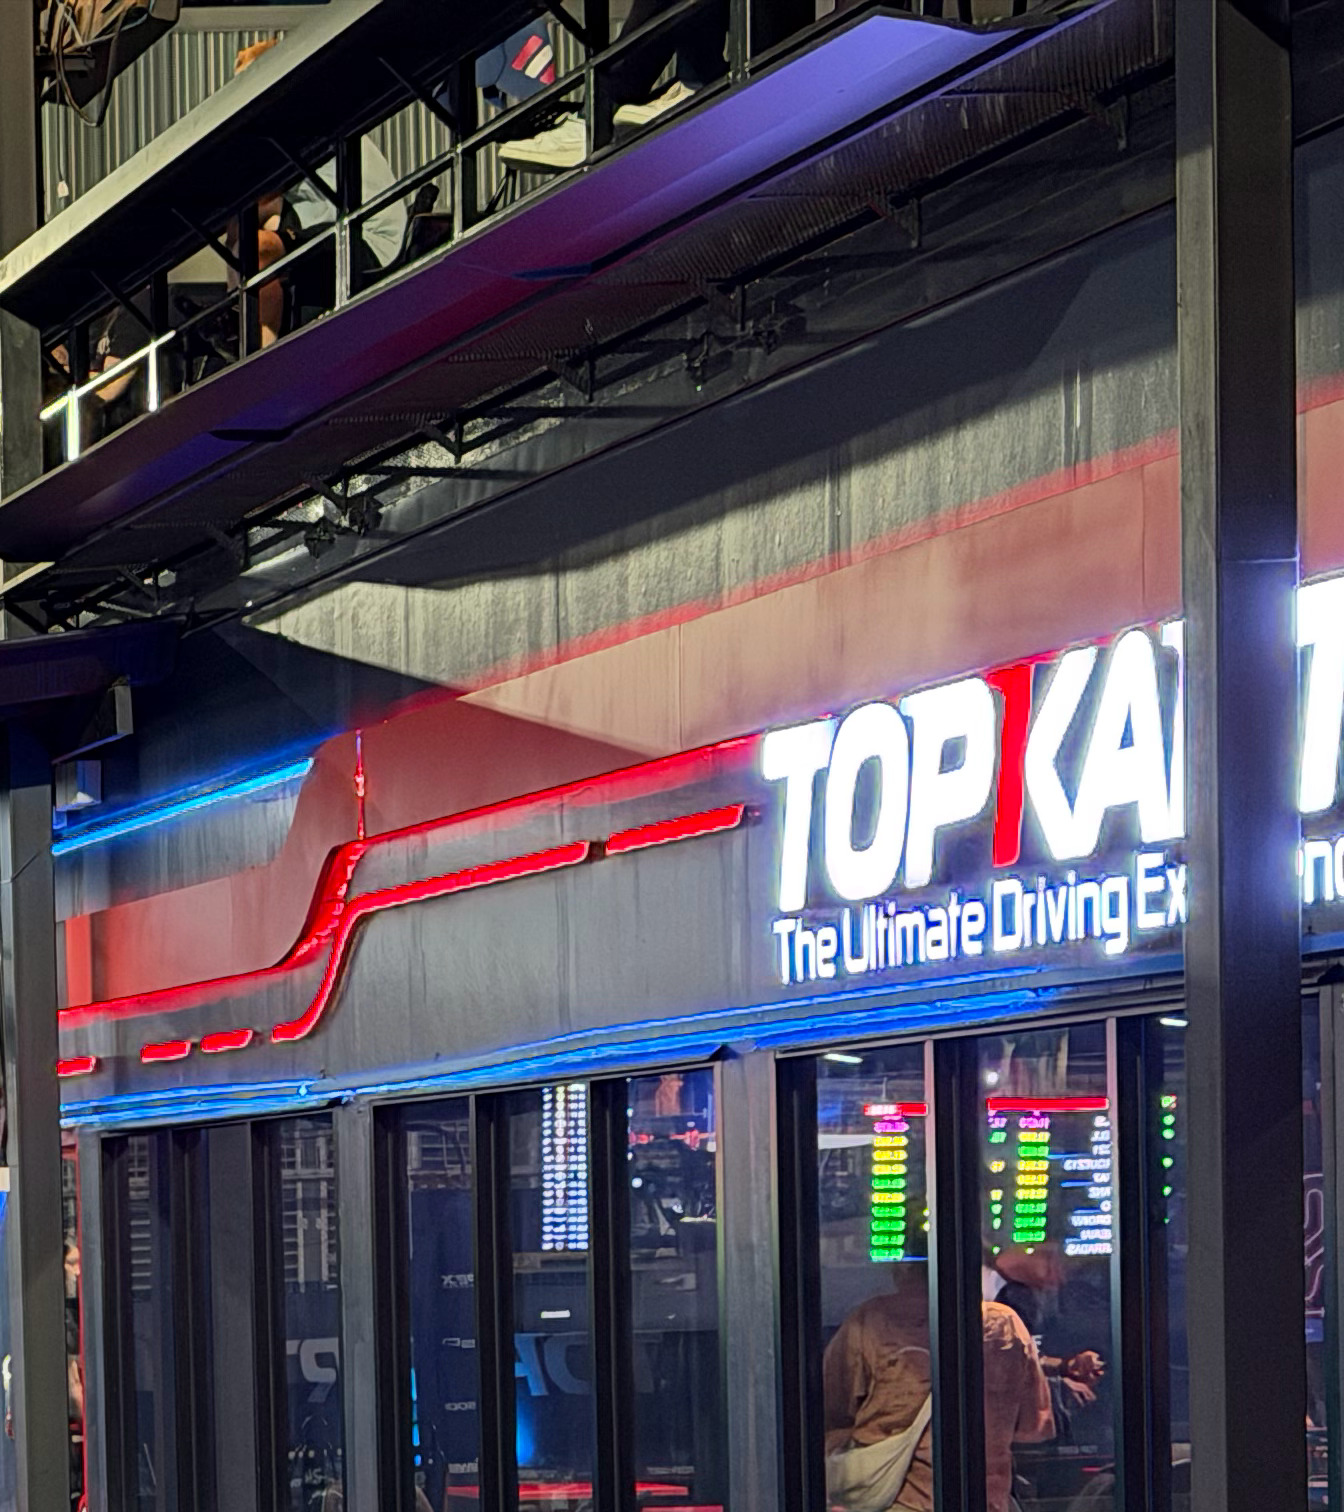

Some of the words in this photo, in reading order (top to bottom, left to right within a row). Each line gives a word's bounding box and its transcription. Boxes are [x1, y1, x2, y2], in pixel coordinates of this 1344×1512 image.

[773, 917, 837, 985] The
[843, 889, 986, 973] Ultimate
[992, 870, 1129, 955] Driving
